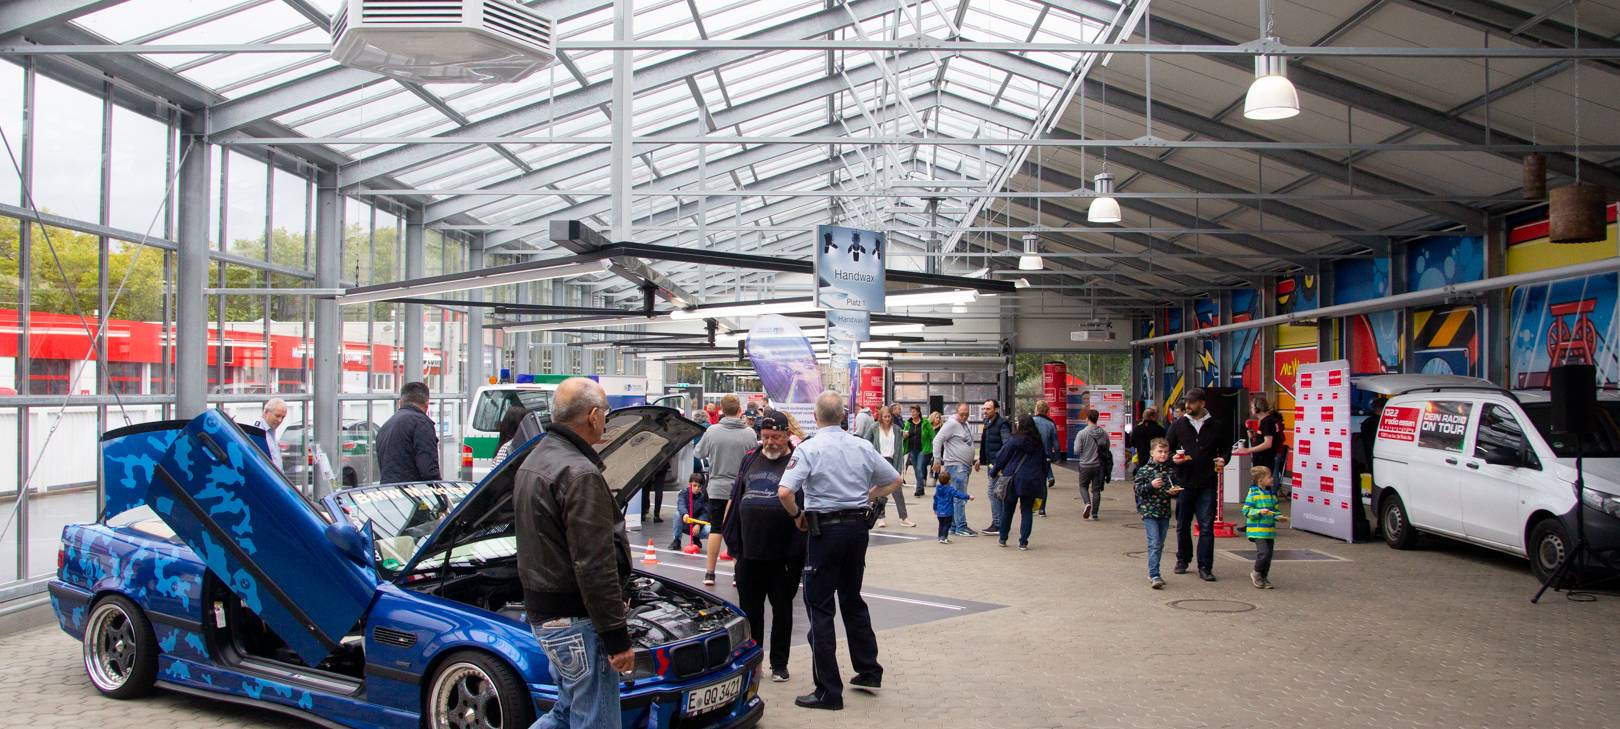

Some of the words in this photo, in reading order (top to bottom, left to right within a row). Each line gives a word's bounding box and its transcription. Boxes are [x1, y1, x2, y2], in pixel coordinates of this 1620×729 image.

[834, 268, 875, 283] Handwax
[846, 298, 861, 307] Platz
[1423, 412, 1441, 421] DEIN
[1441, 414, 1467, 424] RADIO
[1422, 420, 1436, 432] ON
[1438, 423, 1465, 435] TOUR
[688, 693, 696, 710] E
[703, 687, 718, 706] QQ
[719, 679, 739, 700] 3421
